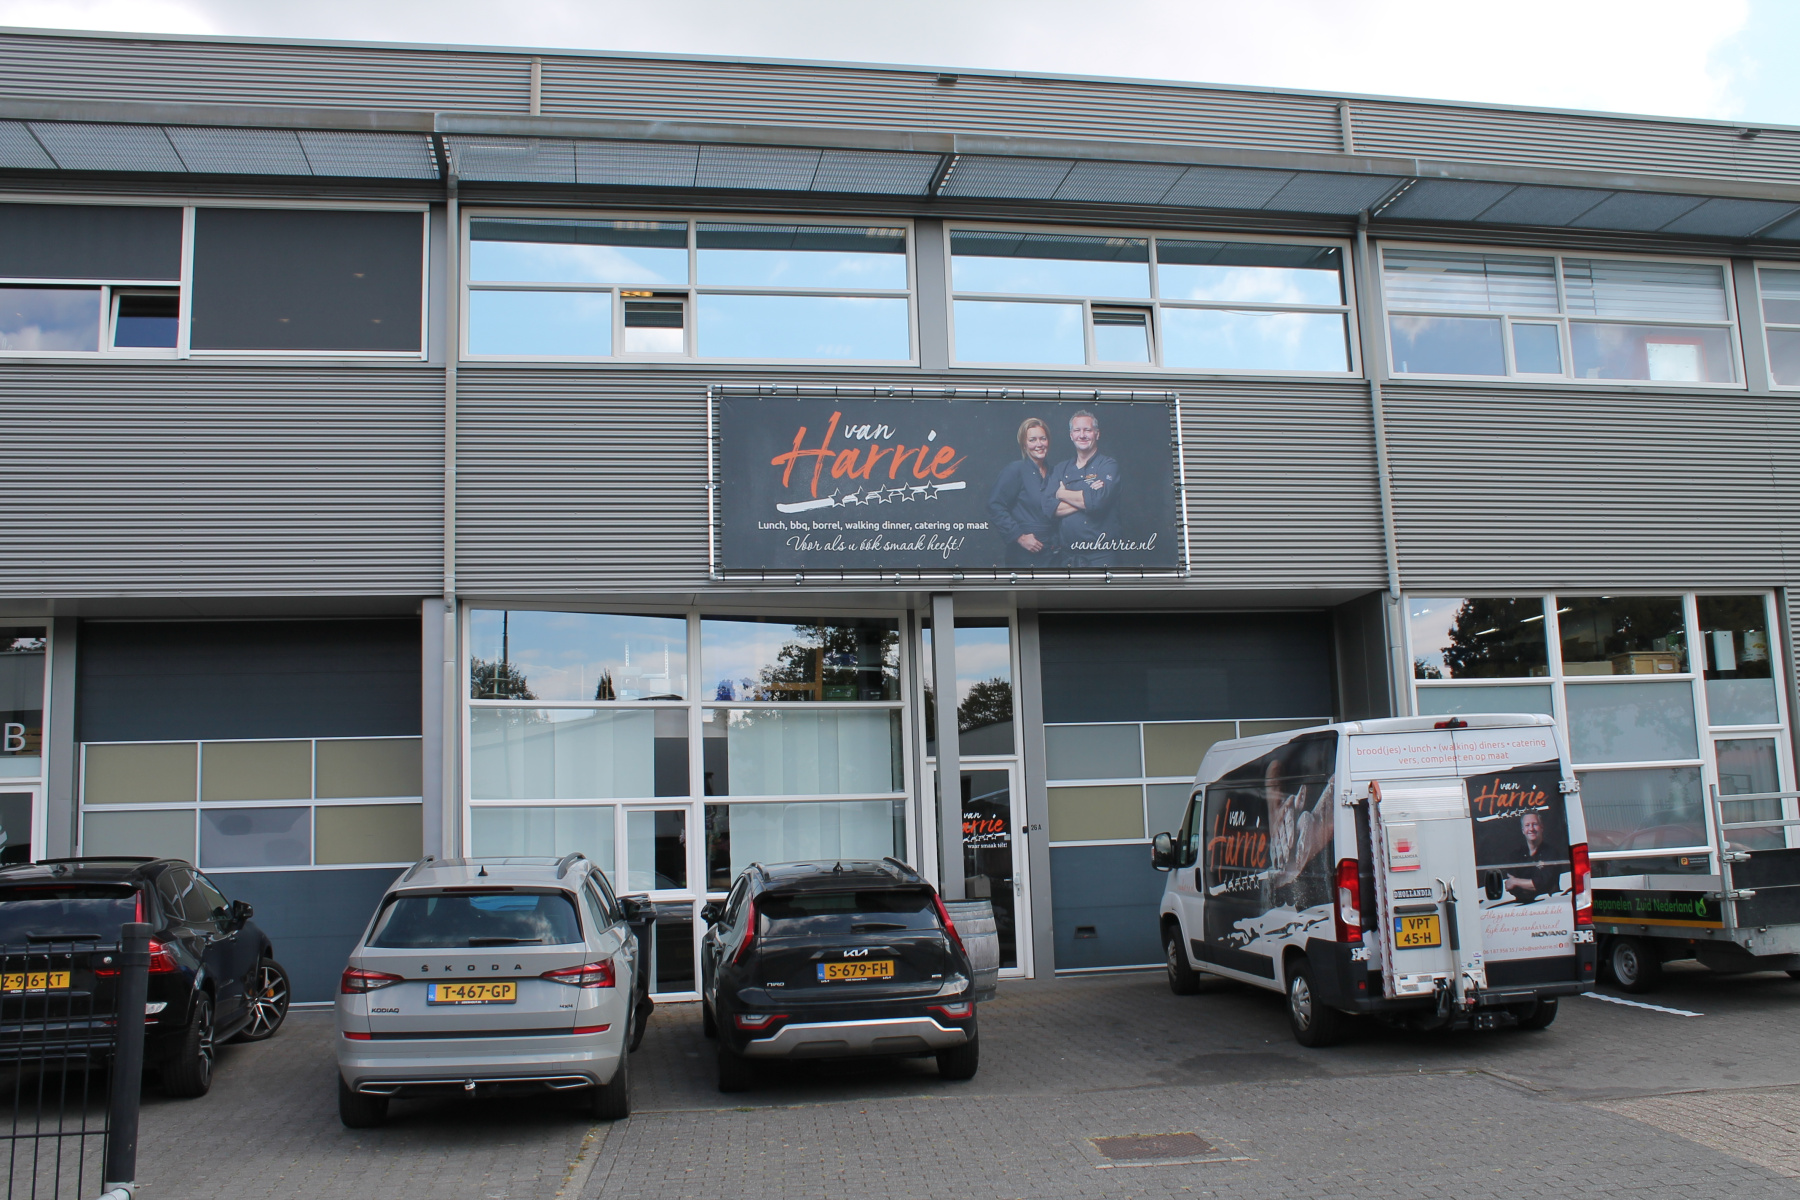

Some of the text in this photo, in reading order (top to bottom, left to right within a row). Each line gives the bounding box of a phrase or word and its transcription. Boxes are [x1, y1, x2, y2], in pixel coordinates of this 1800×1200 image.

[844, 422, 897, 441] van
[770, 410, 968, 499] Harrie
[758, 520, 989, 532] Lunch, bbq, borrel, walking dinner, catering op maat
[786, 533, 822, 551] Voor
[824, 534, 846, 551] als
[848, 541, 859, 551] u
[883, 534, 926, 551] smaak
[926, 534, 966, 560] heeft!
[1070, 532, 1158, 551] vanharrie.nl
[4, 722, 26, 751] B
[1356, 738, 1547, 756] brood(jes) lunch (walking) diners catering
[1398, 752, 1509, 765] vers, compleet en op maat
[1500, 782, 1521, 791] van
[1473, 777, 1550, 815] Harrie
[963, 811, 982, 819] van
[1229, 810, 1247, 827] van
[962, 813, 1008, 834] arrie
[1207, 798, 1270, 883] Harrie
[1393, 889, 1433, 898] DHOLLANDIA
[1635, 898, 1652, 911] Zuid
[1654, 898, 1693, 913] Nederland
[1409, 917, 1431, 930] VPT
[1404, 931, 1432, 944] 45-H
[1531, 929, 1568, 938] MOVANO
[843, 948, 869, 957] KIA
[829, 962, 889, 977] S-679-FH
[443, 984, 511, 999] T-467-GP
